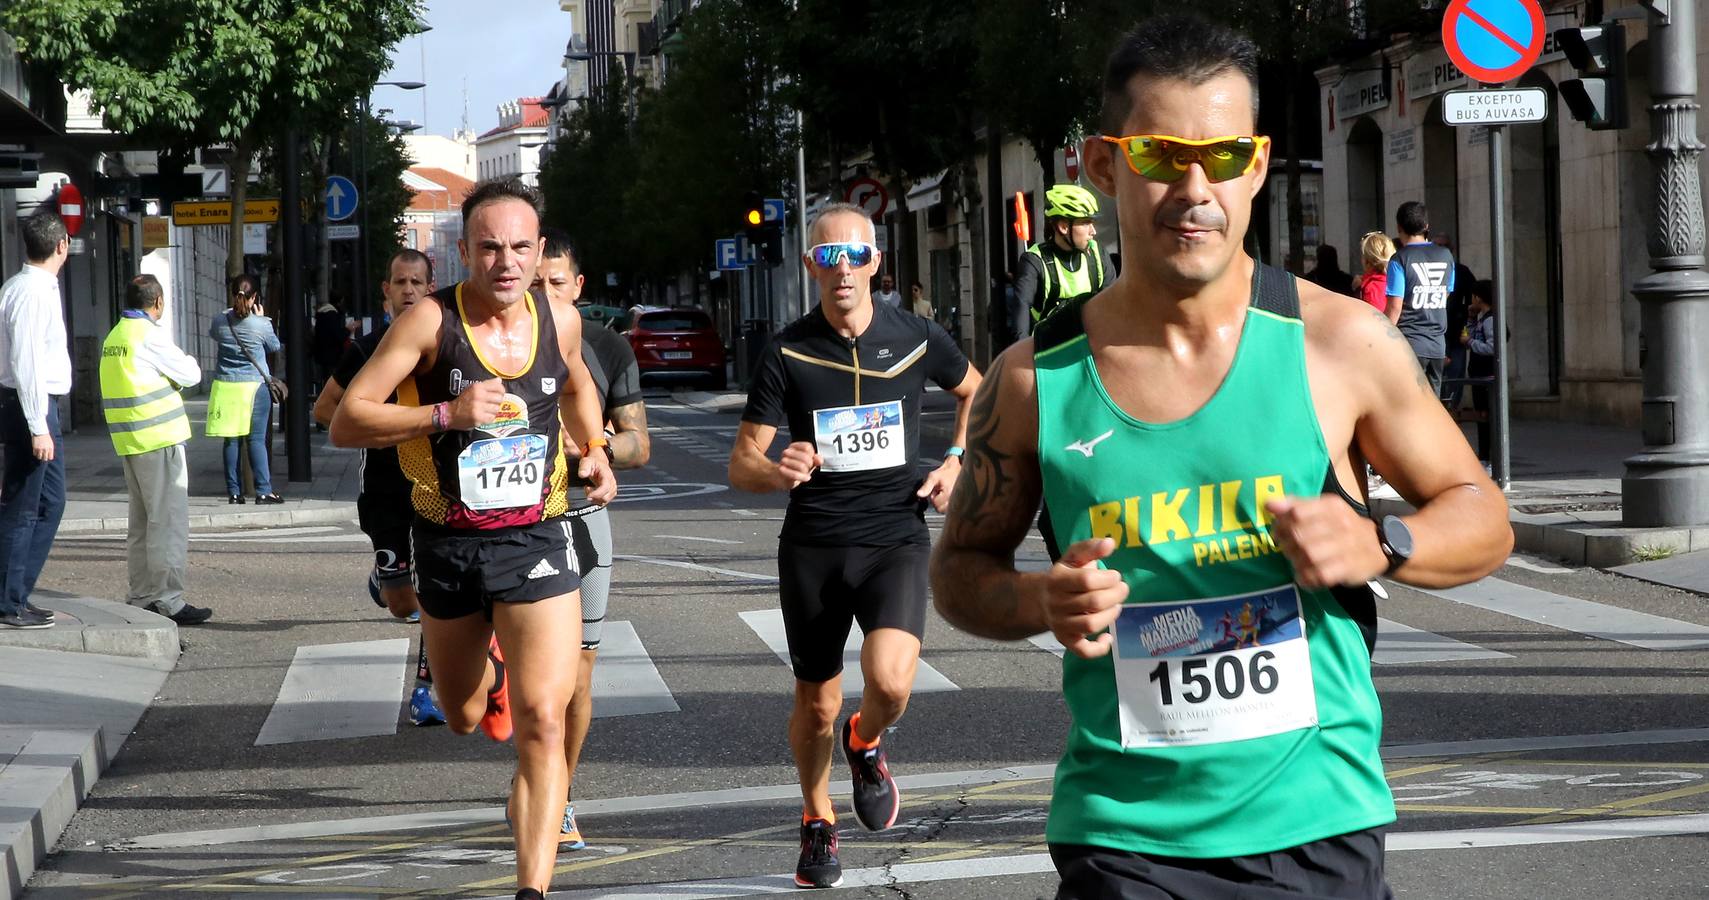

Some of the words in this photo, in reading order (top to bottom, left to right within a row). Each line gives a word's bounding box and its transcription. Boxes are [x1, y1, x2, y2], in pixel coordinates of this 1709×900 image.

[1469, 94, 1522, 106] EXCEPTO
[1456, 109, 1480, 120] BUS
[1485, 107, 1535, 119] AUVASA
[200, 207, 228, 217] Enara
[832, 429, 890, 455] 1396
[476, 462, 538, 489] 1740
[1088, 475, 1285, 549] BIKILA
[1152, 606, 1197, 630] MEDIA
[1140, 616, 1203, 647] MARATON
[1148, 650, 1279, 706] 1506
